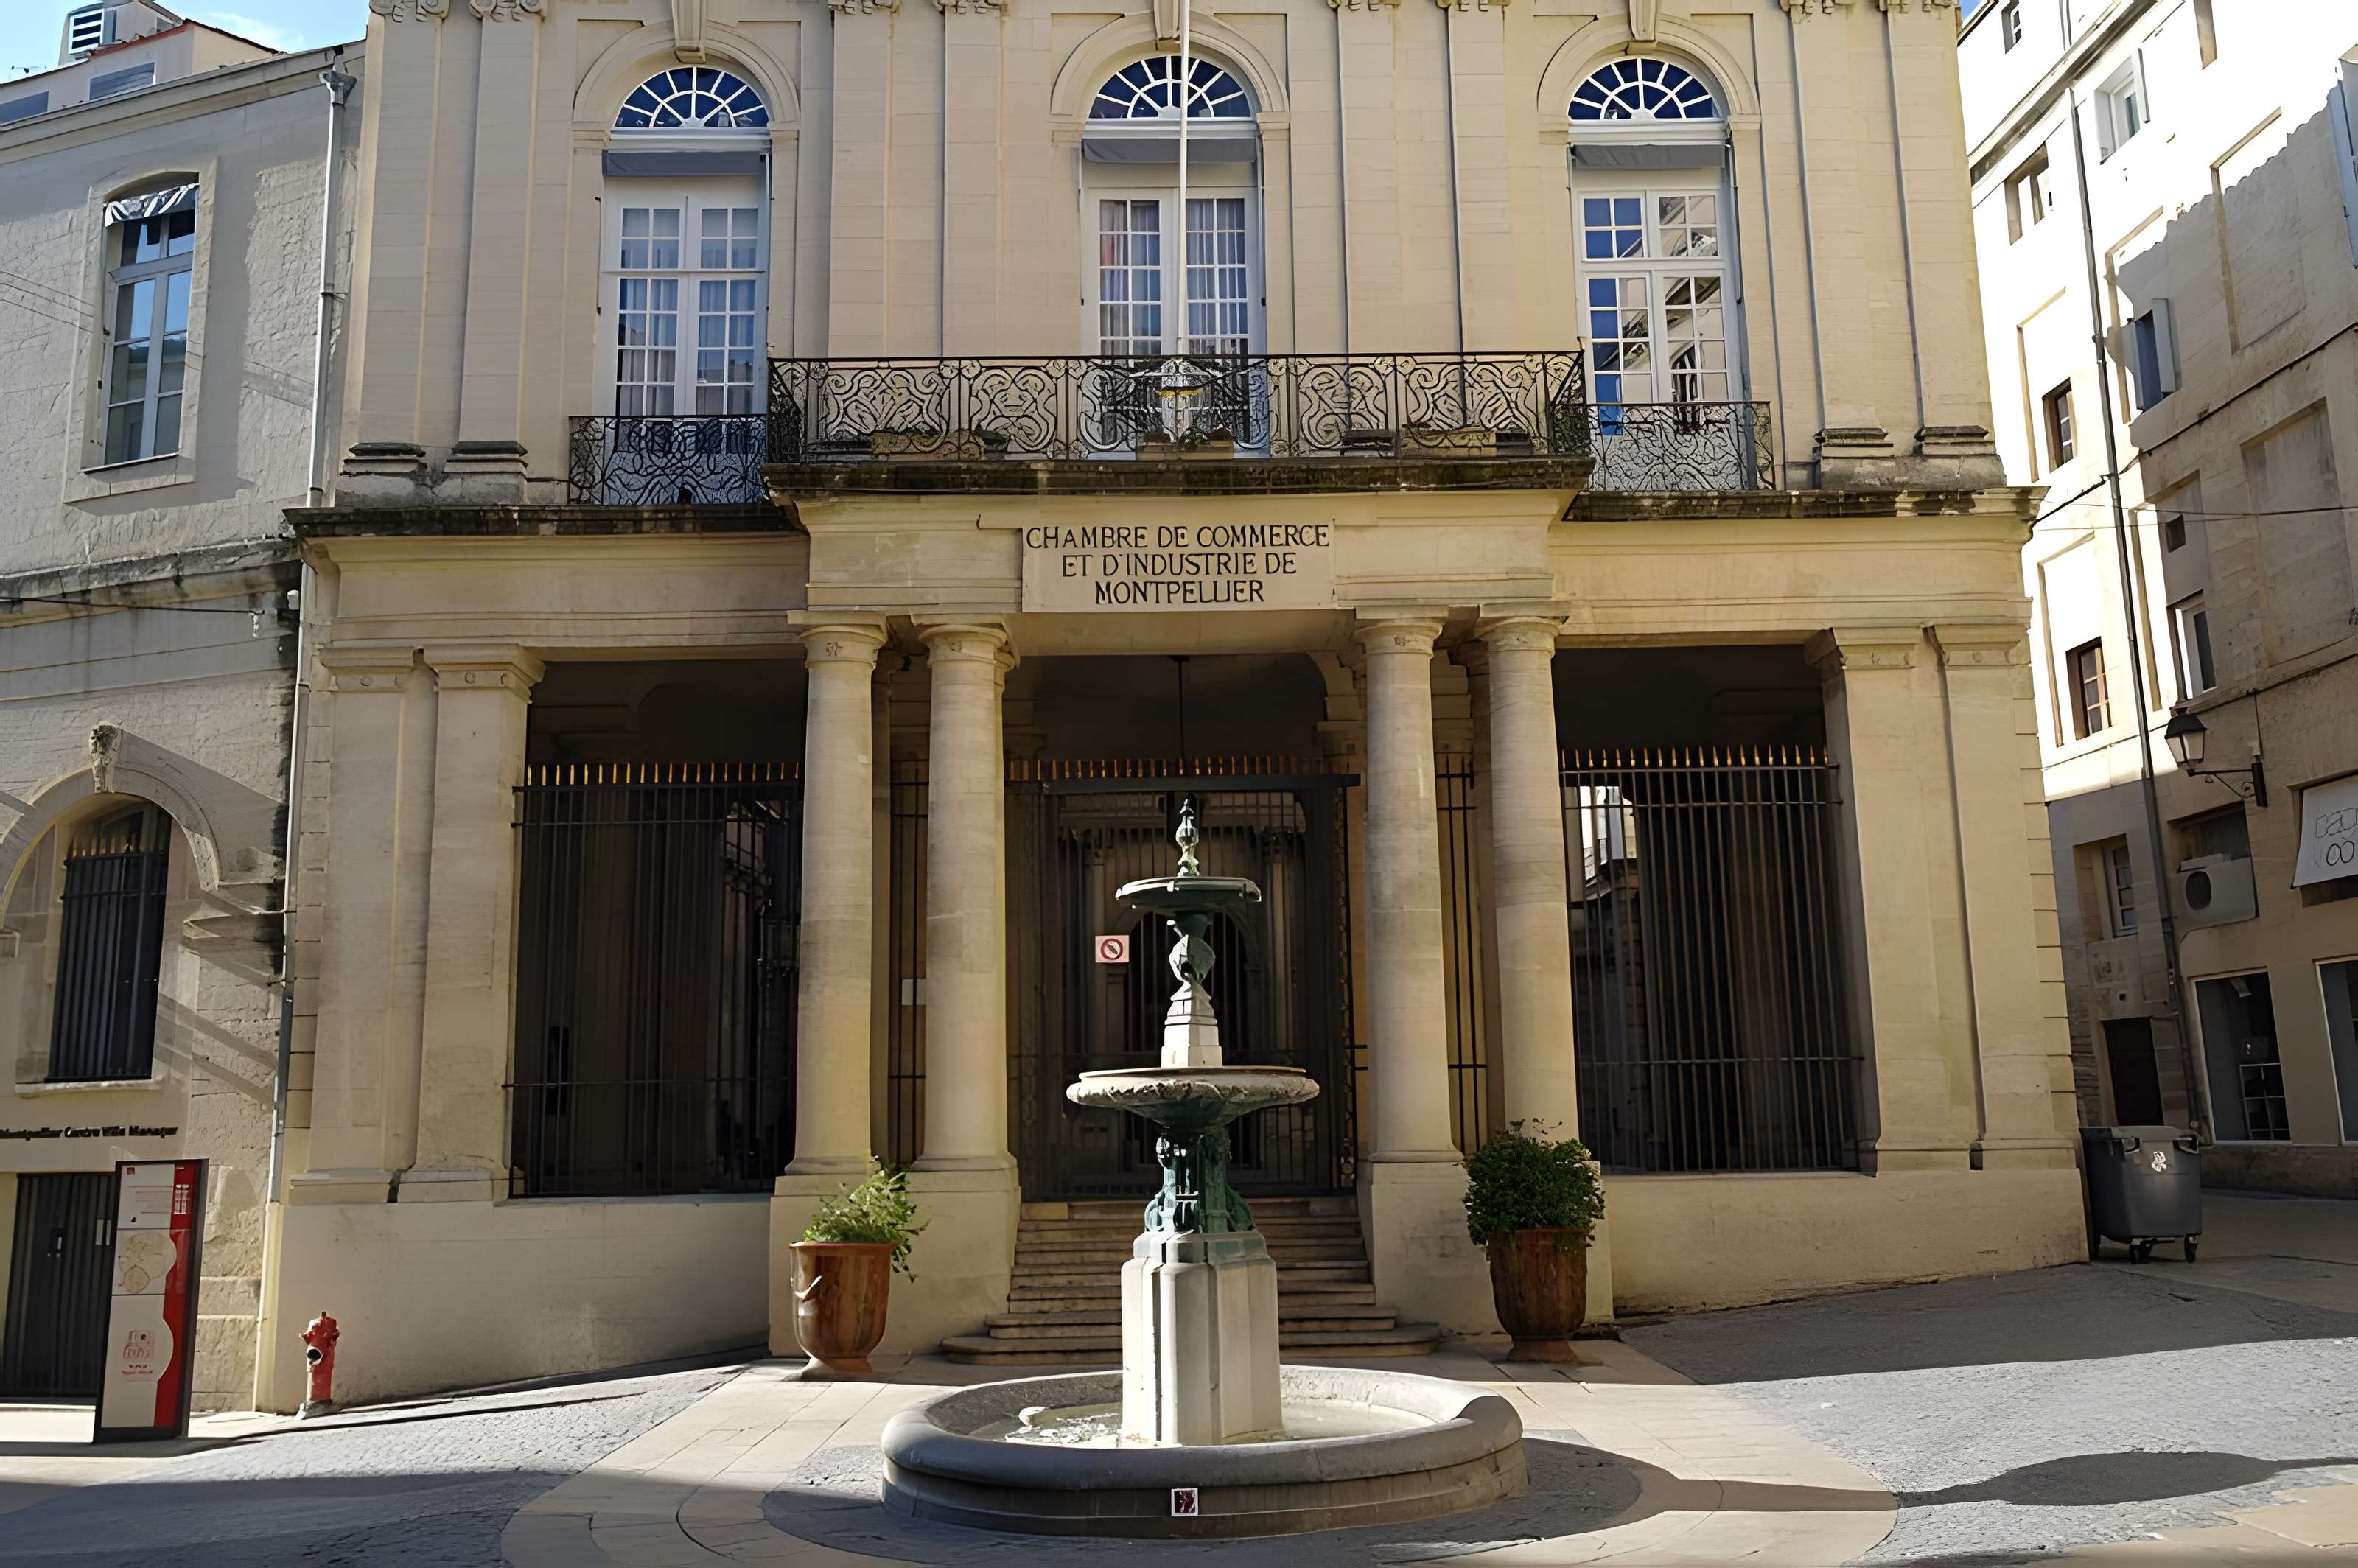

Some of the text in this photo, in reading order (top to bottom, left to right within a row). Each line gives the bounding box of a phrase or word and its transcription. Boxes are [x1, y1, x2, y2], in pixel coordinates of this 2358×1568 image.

[1026, 524, 1329, 549] CHAMBRE DE COMMERCE
[1062, 552, 1297, 578] ET D'INDUSTRIE DE
[1095, 579, 1264, 605] MONTPELLIER
